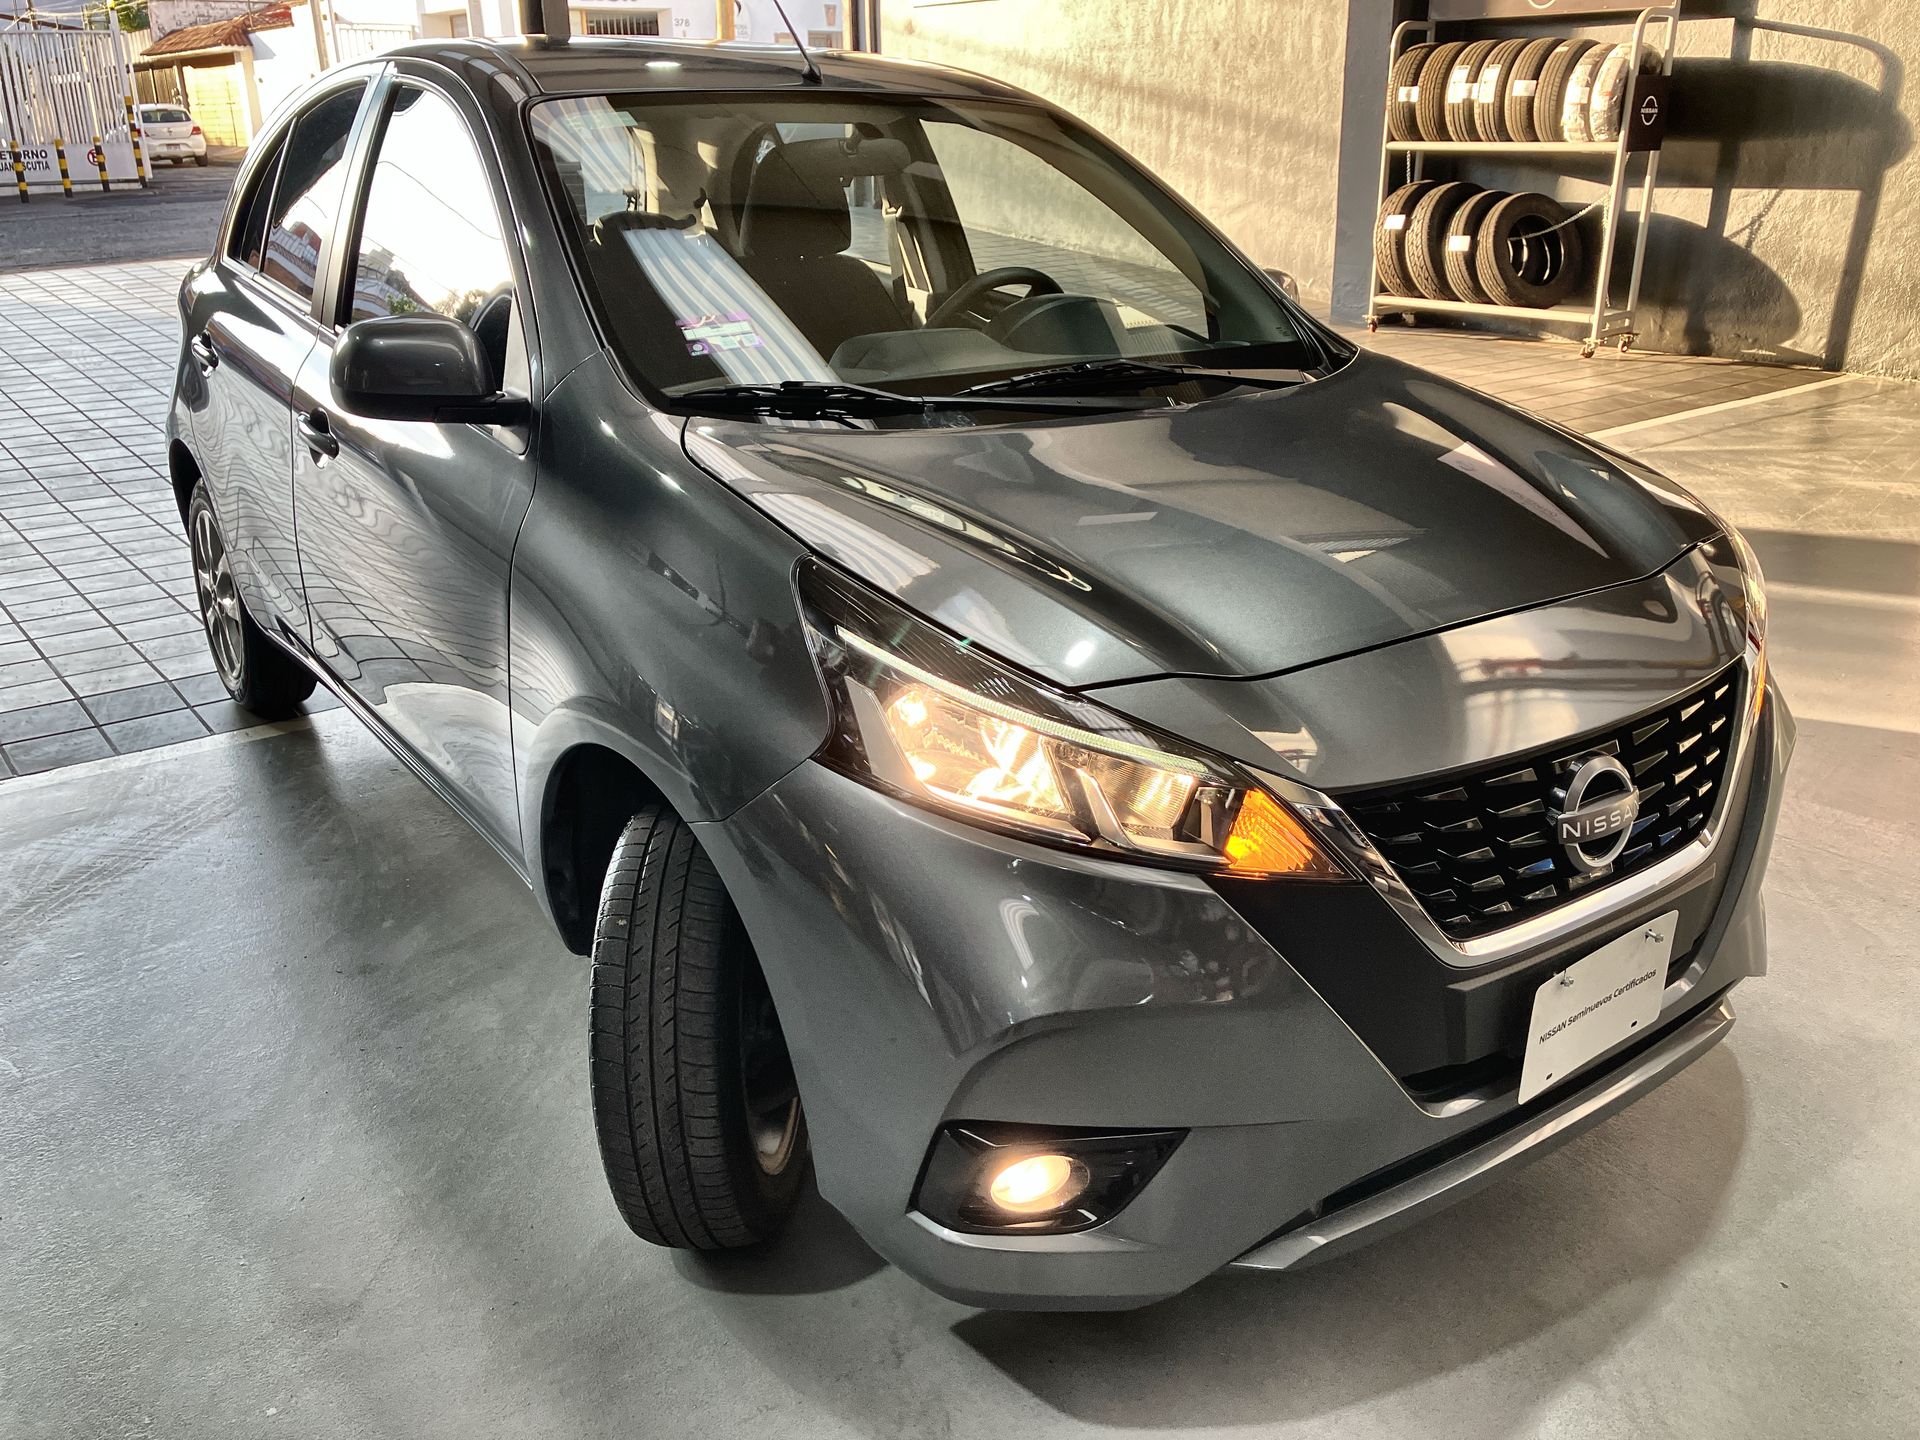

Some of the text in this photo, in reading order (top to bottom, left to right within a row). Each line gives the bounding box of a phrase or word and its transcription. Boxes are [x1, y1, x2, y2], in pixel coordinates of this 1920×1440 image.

[1539, 969, 1657, 1044] NISSAN Seminuevos Certificados
